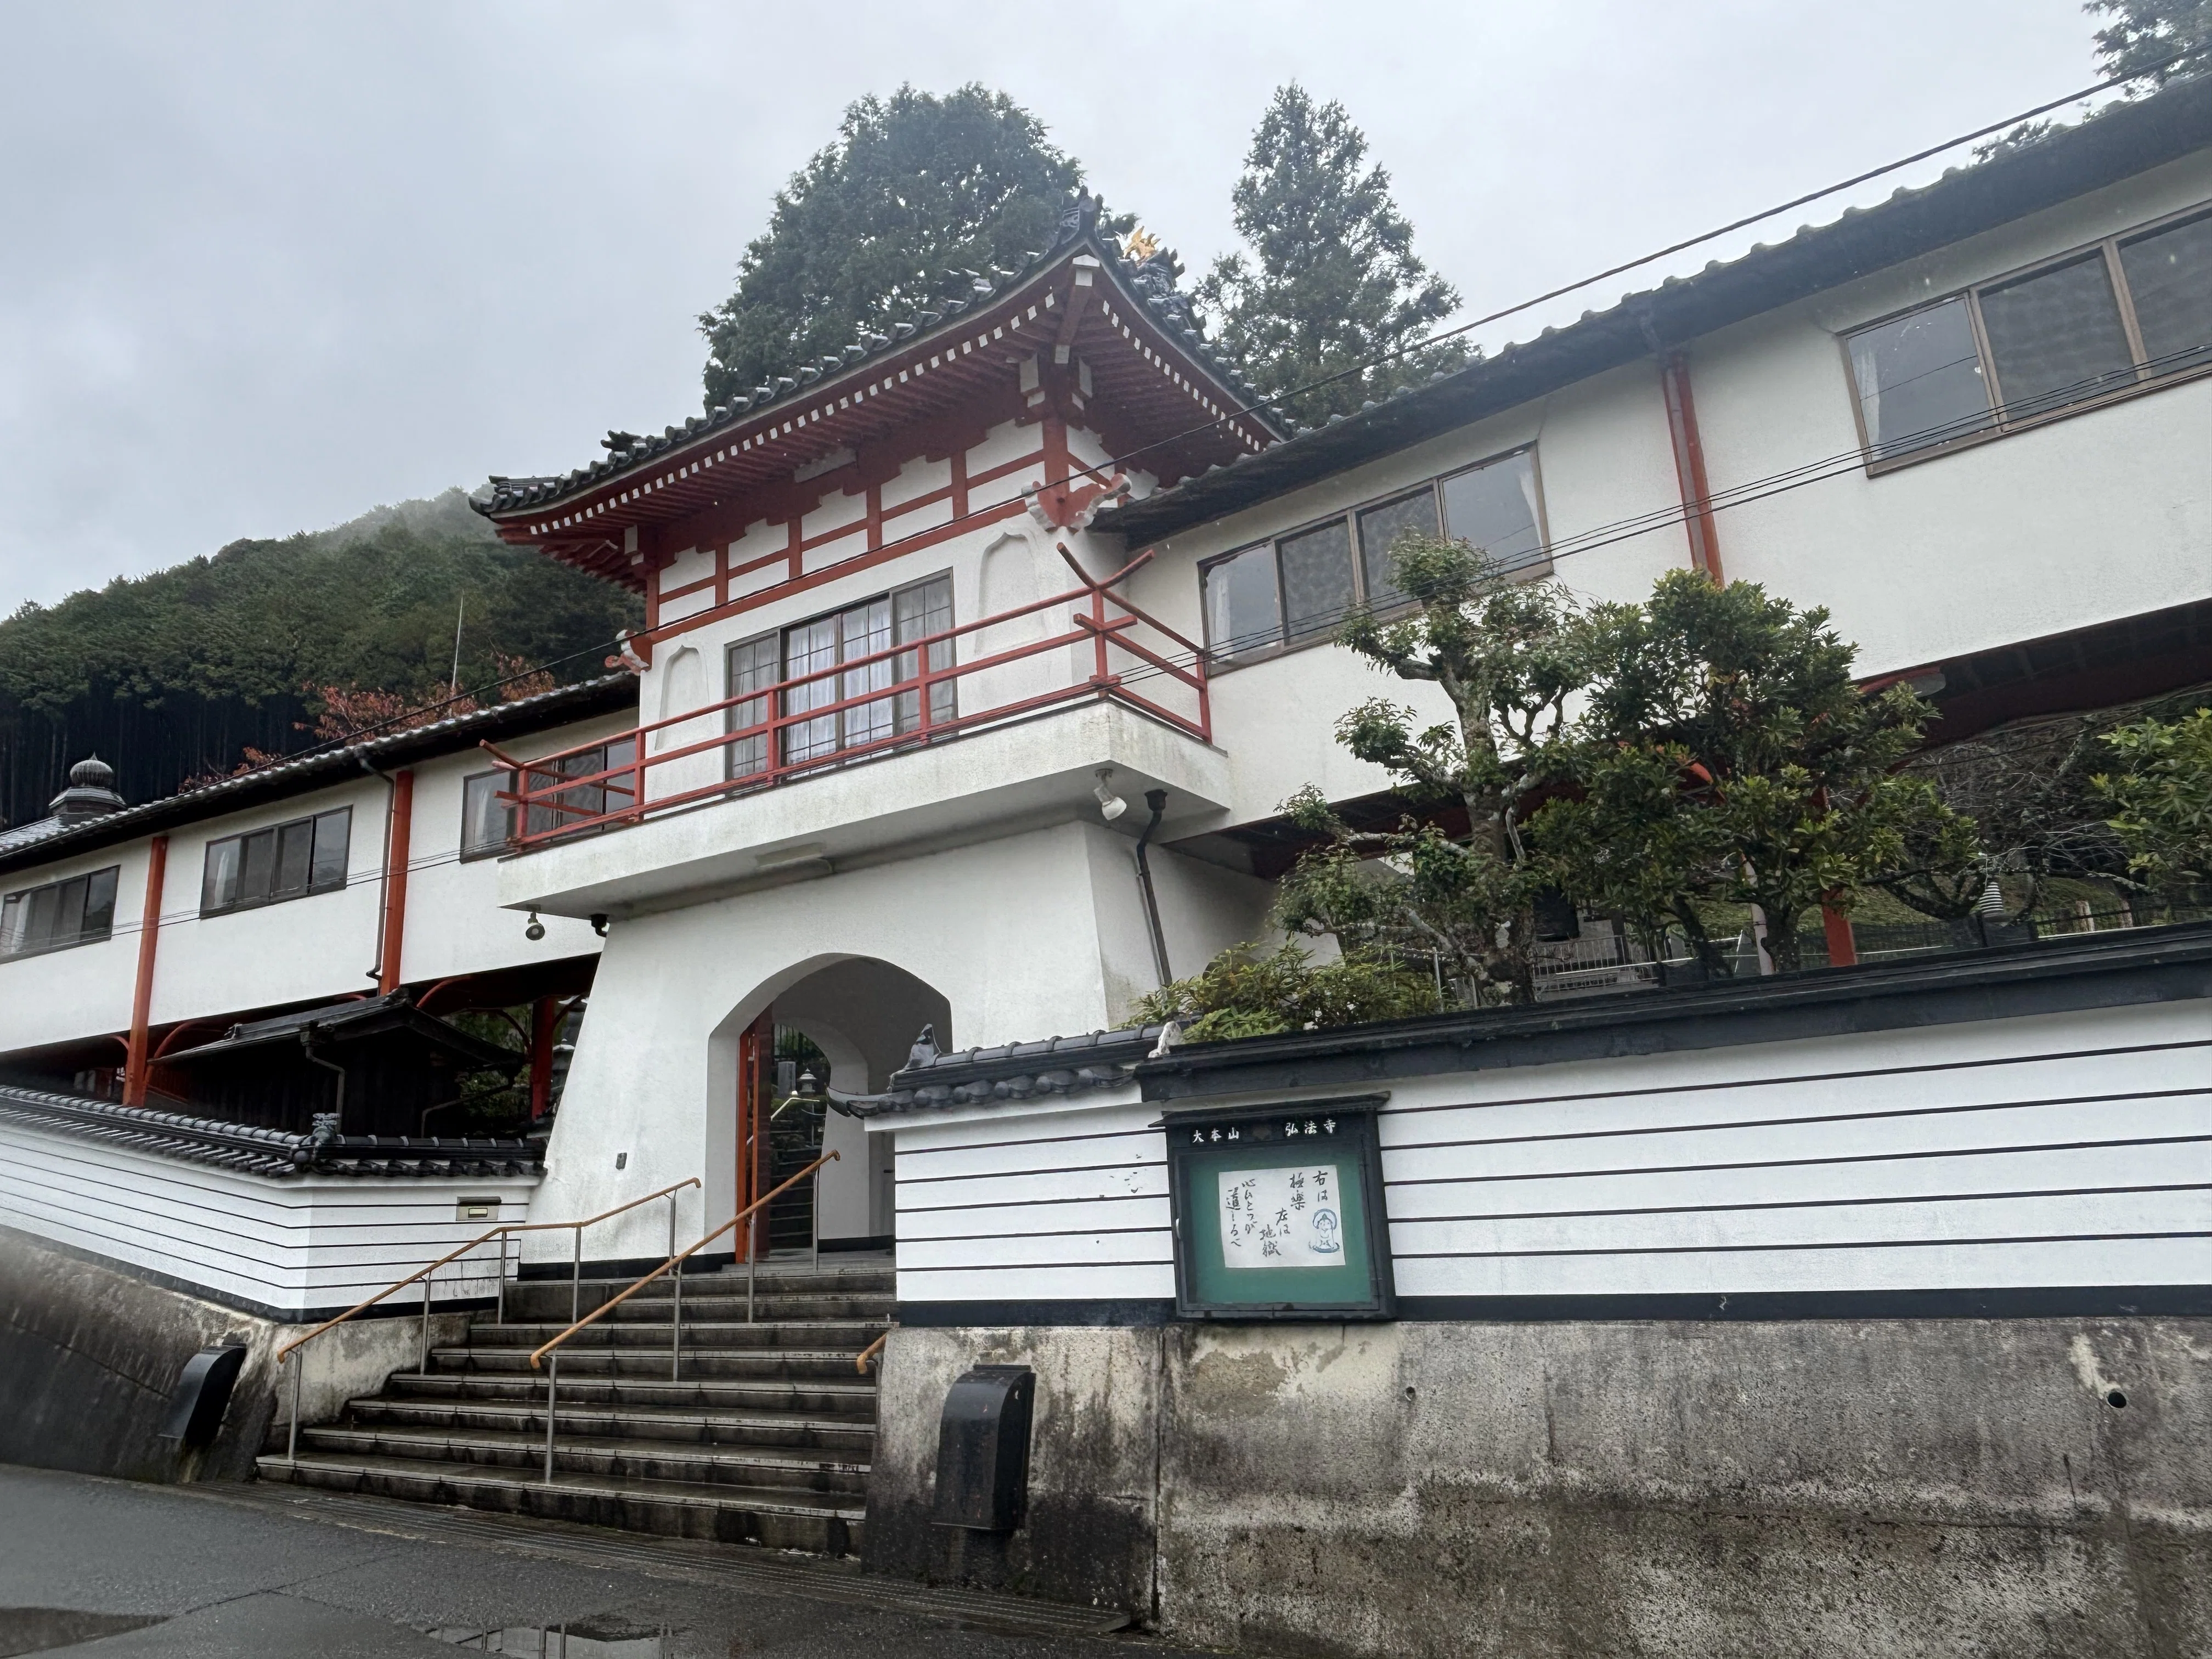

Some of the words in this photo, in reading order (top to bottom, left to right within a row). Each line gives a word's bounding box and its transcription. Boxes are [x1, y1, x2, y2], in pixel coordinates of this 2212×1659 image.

[1193, 1127, 1239, 1143] 大本山
[1285, 1119, 1336, 1136] 弘法寺
[1313, 1170, 1328, 1203] 右は
[1226, 1187, 1242, 1247] 道しるべ
[1242, 1178, 1257, 1234] 心ひとつが
[1275, 1207, 1290, 1237] 左は
[1259, 1224, 1282, 1257] 地獄
